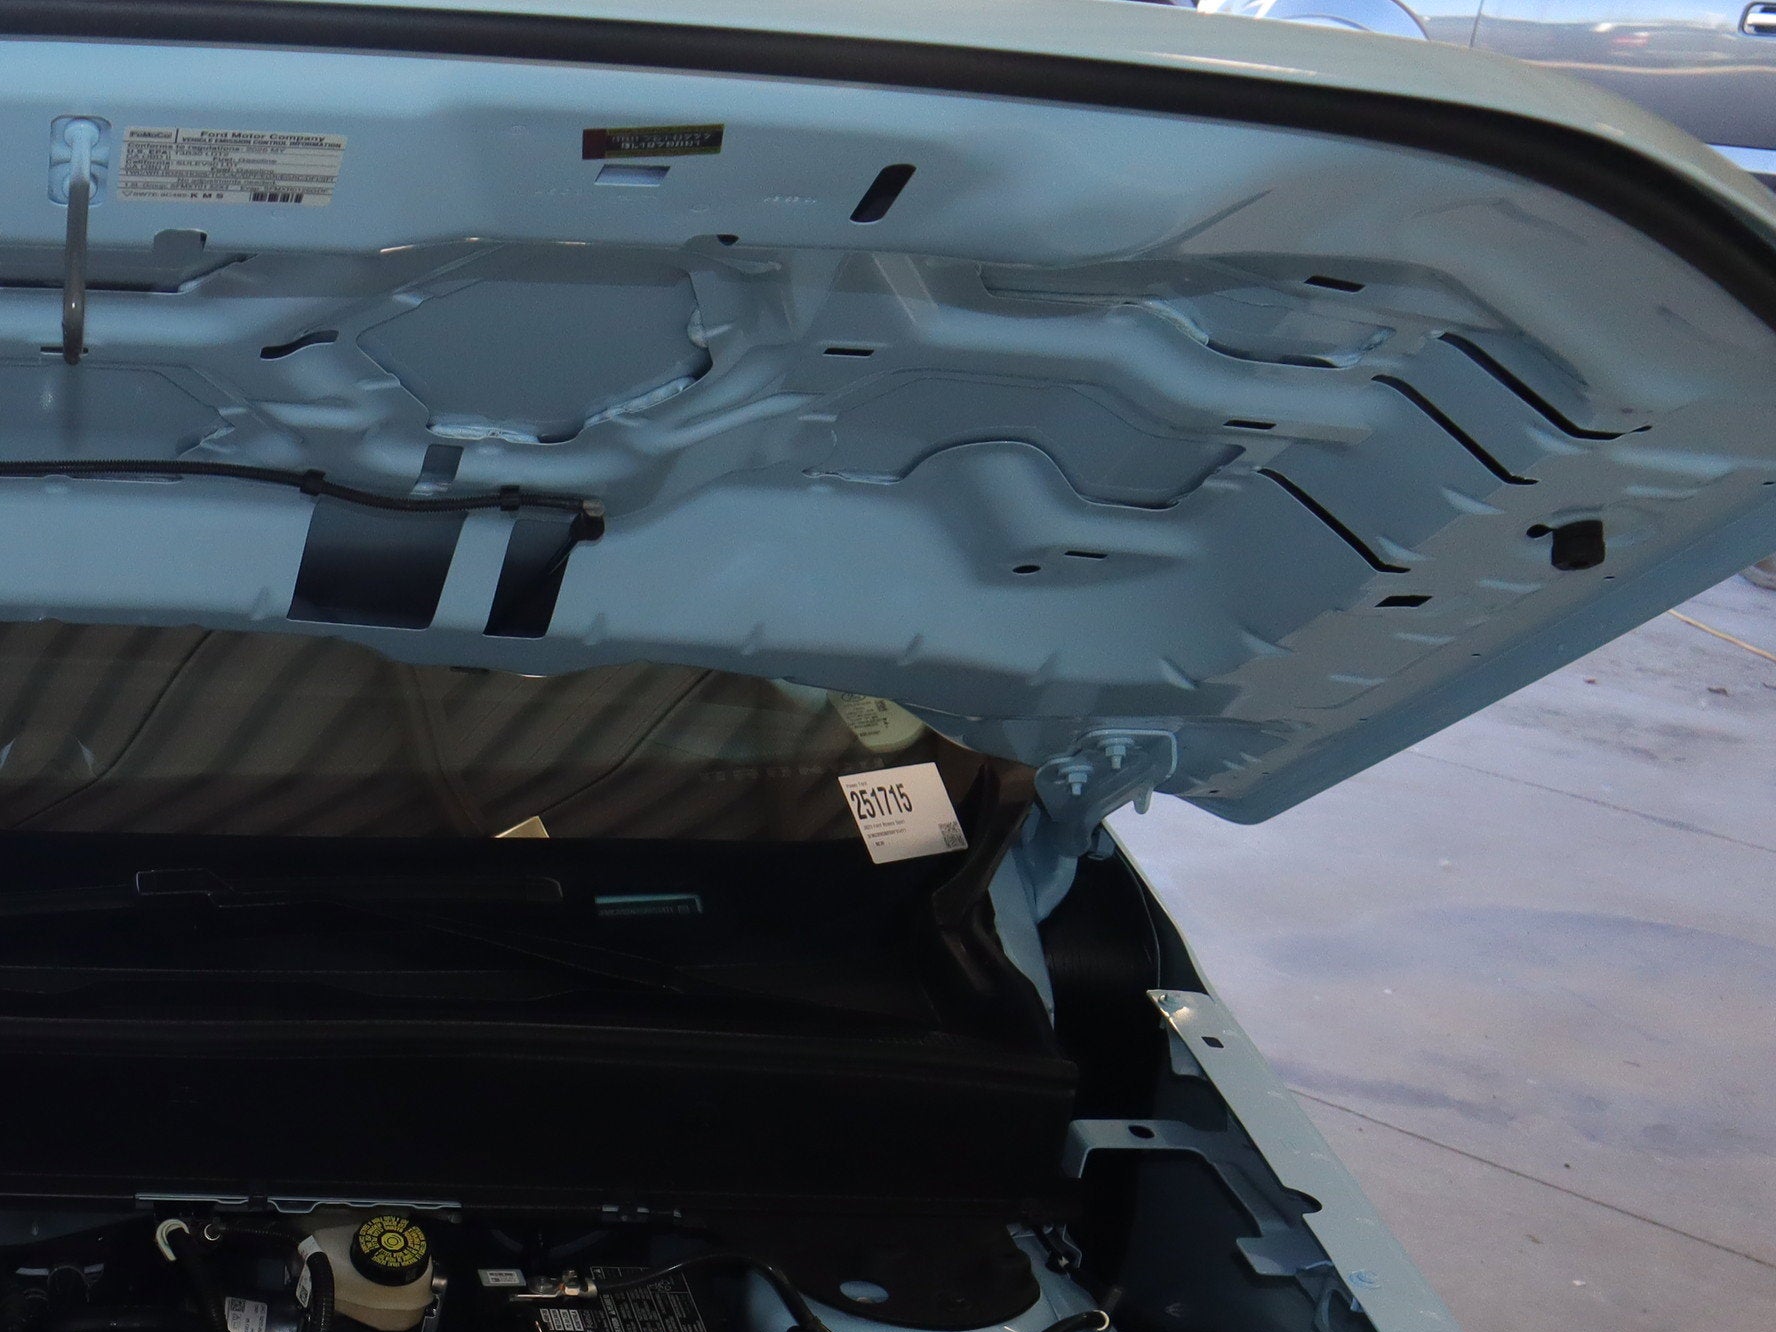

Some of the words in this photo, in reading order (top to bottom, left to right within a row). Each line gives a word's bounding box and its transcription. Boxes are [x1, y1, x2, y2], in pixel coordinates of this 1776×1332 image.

[129, 130, 173, 140] FoMoCo
[200, 130, 228, 139] Ford
[232, 131, 265, 140] Motor
[269, 133, 326, 143] Company
[850, 783, 913, 820] 251715
